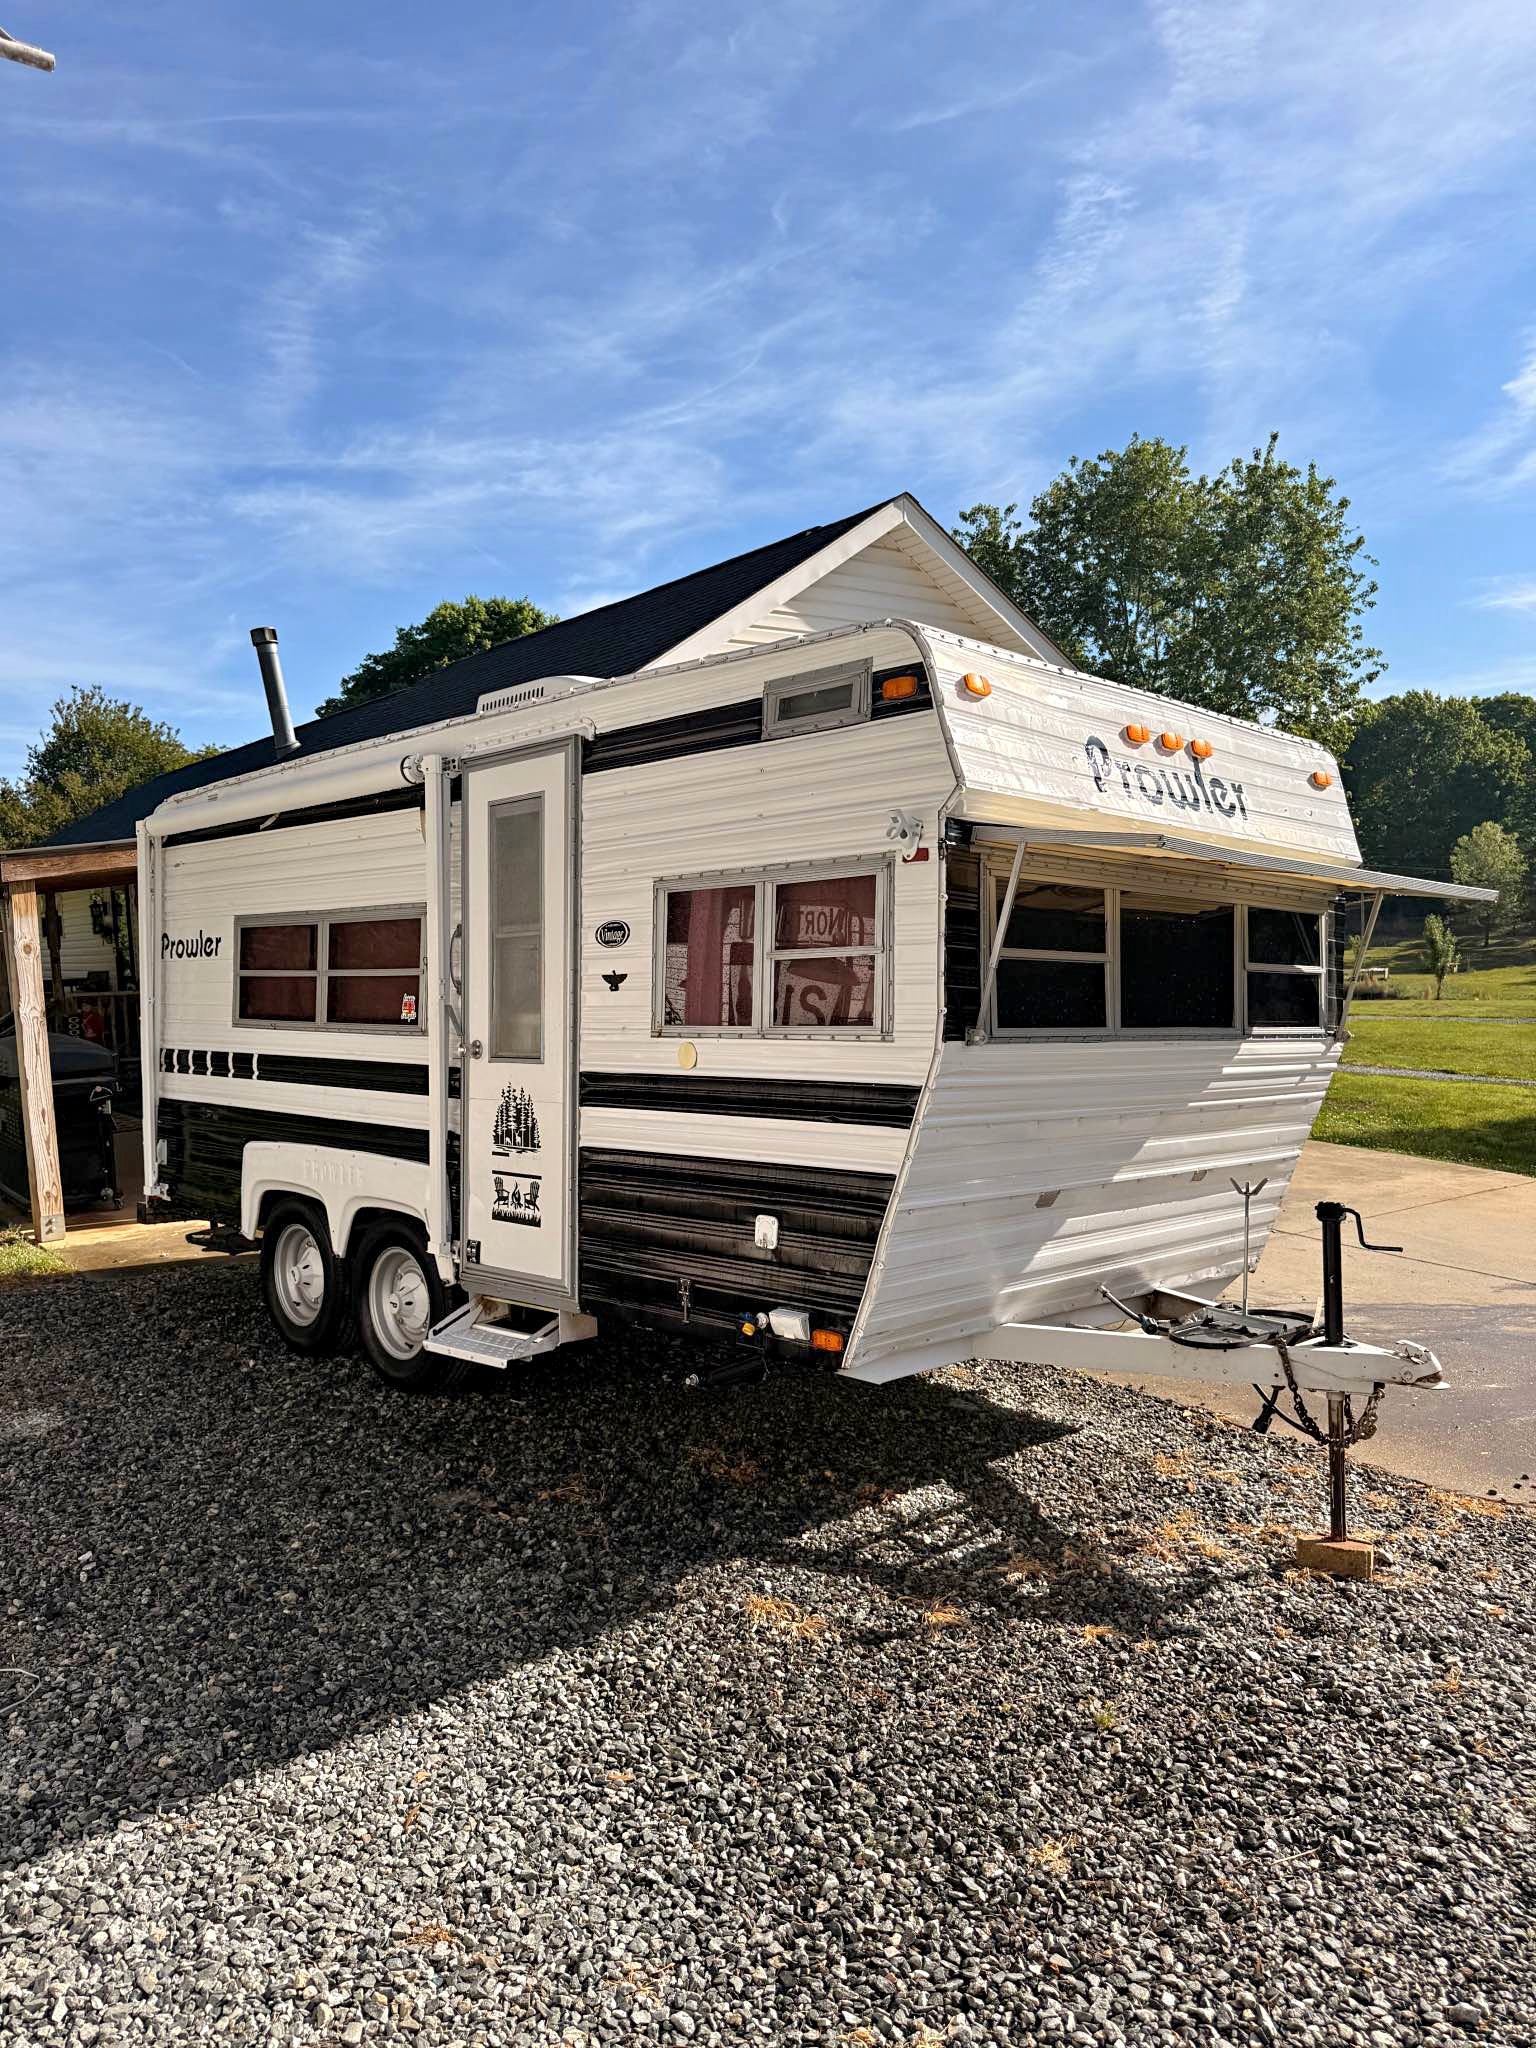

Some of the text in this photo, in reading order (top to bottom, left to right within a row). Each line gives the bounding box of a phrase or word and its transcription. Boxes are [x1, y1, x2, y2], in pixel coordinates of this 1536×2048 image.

[1084, 735, 1249, 821] Prowler
[161, 929, 222, 960] Prowler
[601, 928, 625, 944] Vintage
